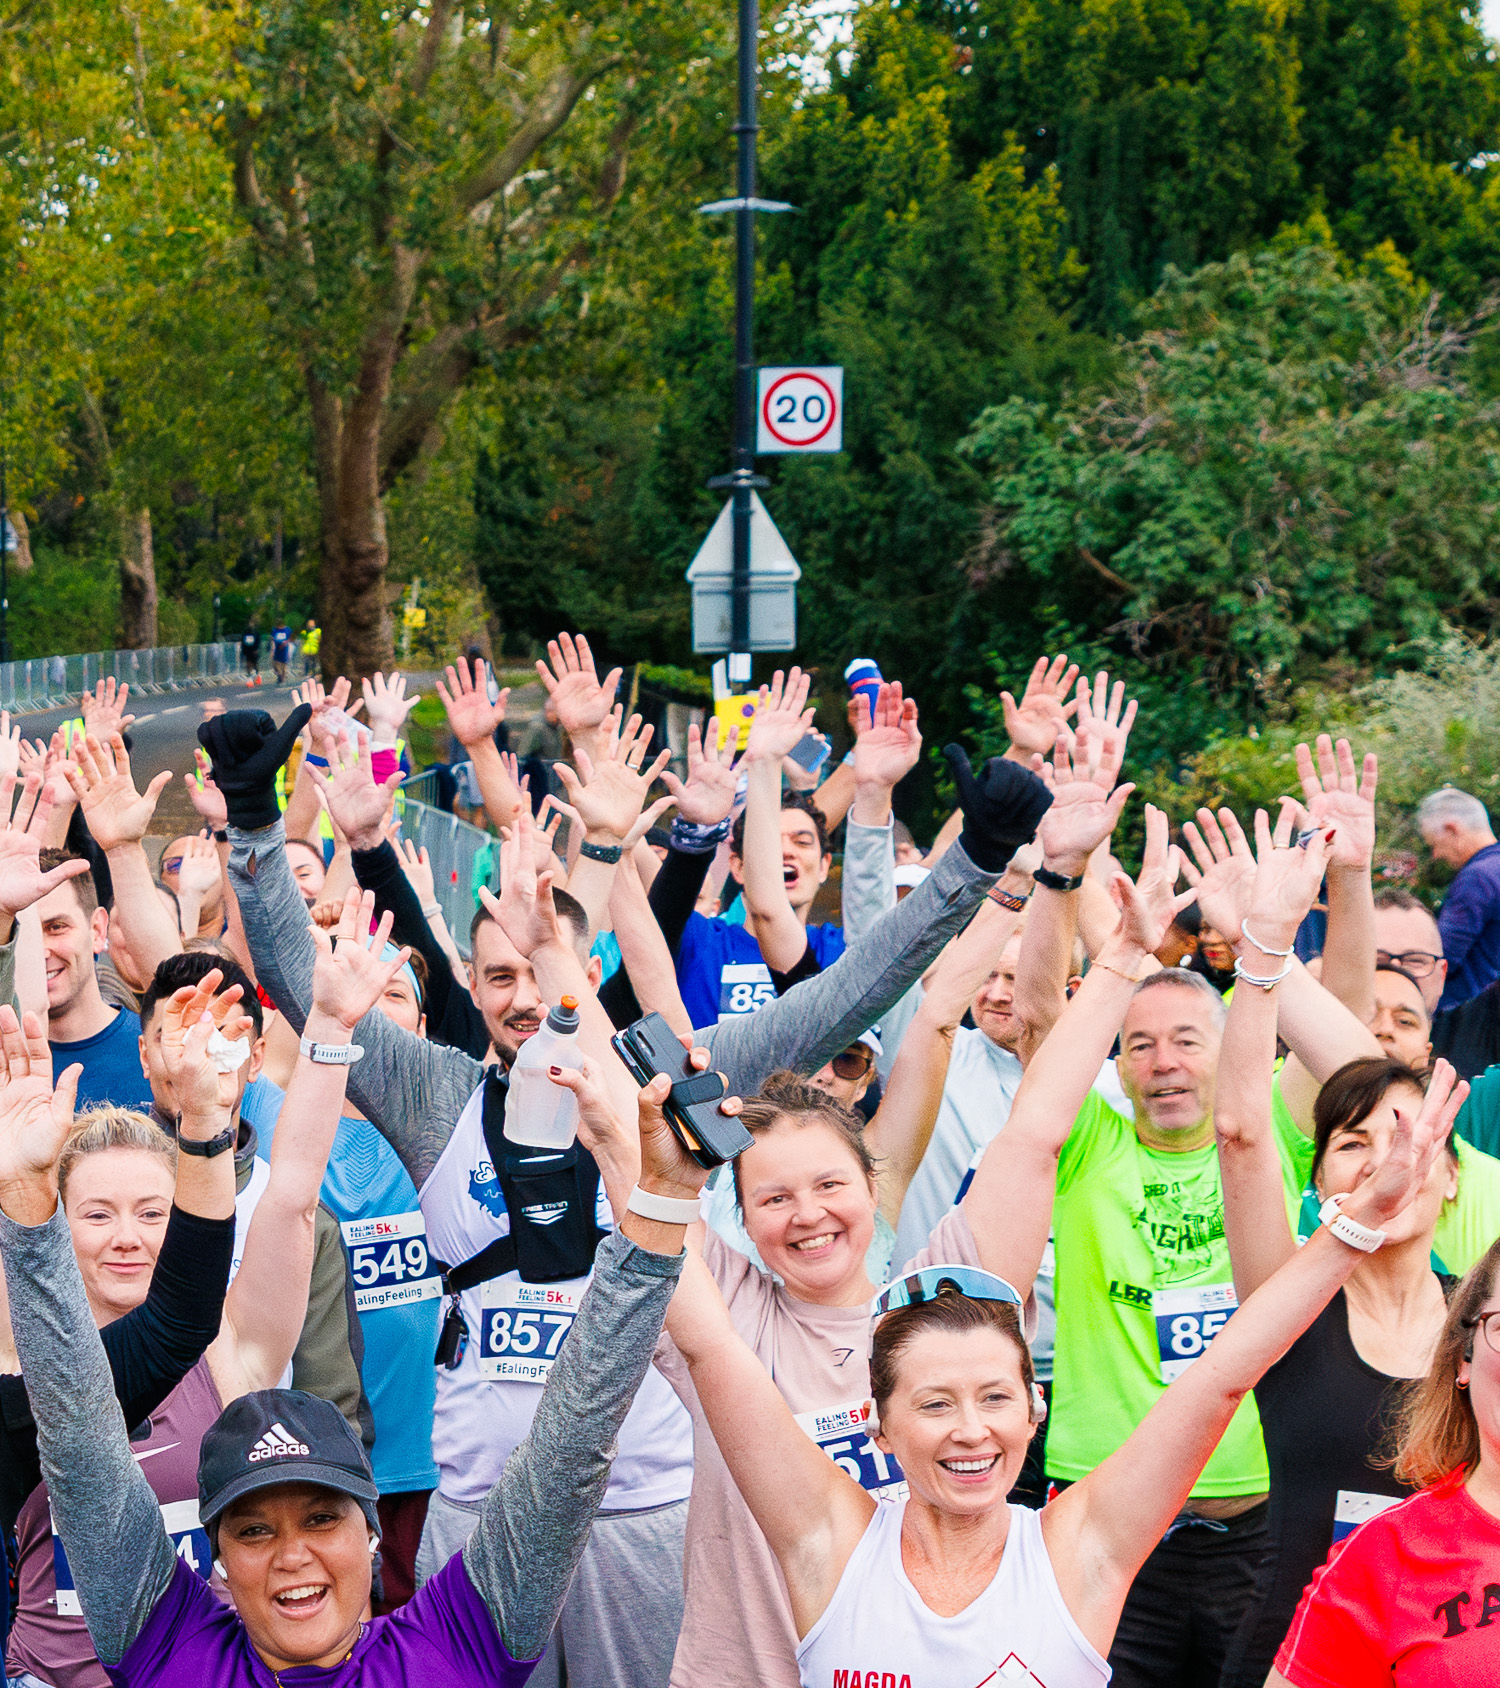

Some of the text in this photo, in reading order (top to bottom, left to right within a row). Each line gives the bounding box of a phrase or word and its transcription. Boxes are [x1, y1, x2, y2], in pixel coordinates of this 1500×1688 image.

[776, 395, 825, 423] 20
[815, 1411, 848, 1426] EALING
[817, 1420, 850, 1432] FEELING
[248, 1439, 309, 1462] adidas
